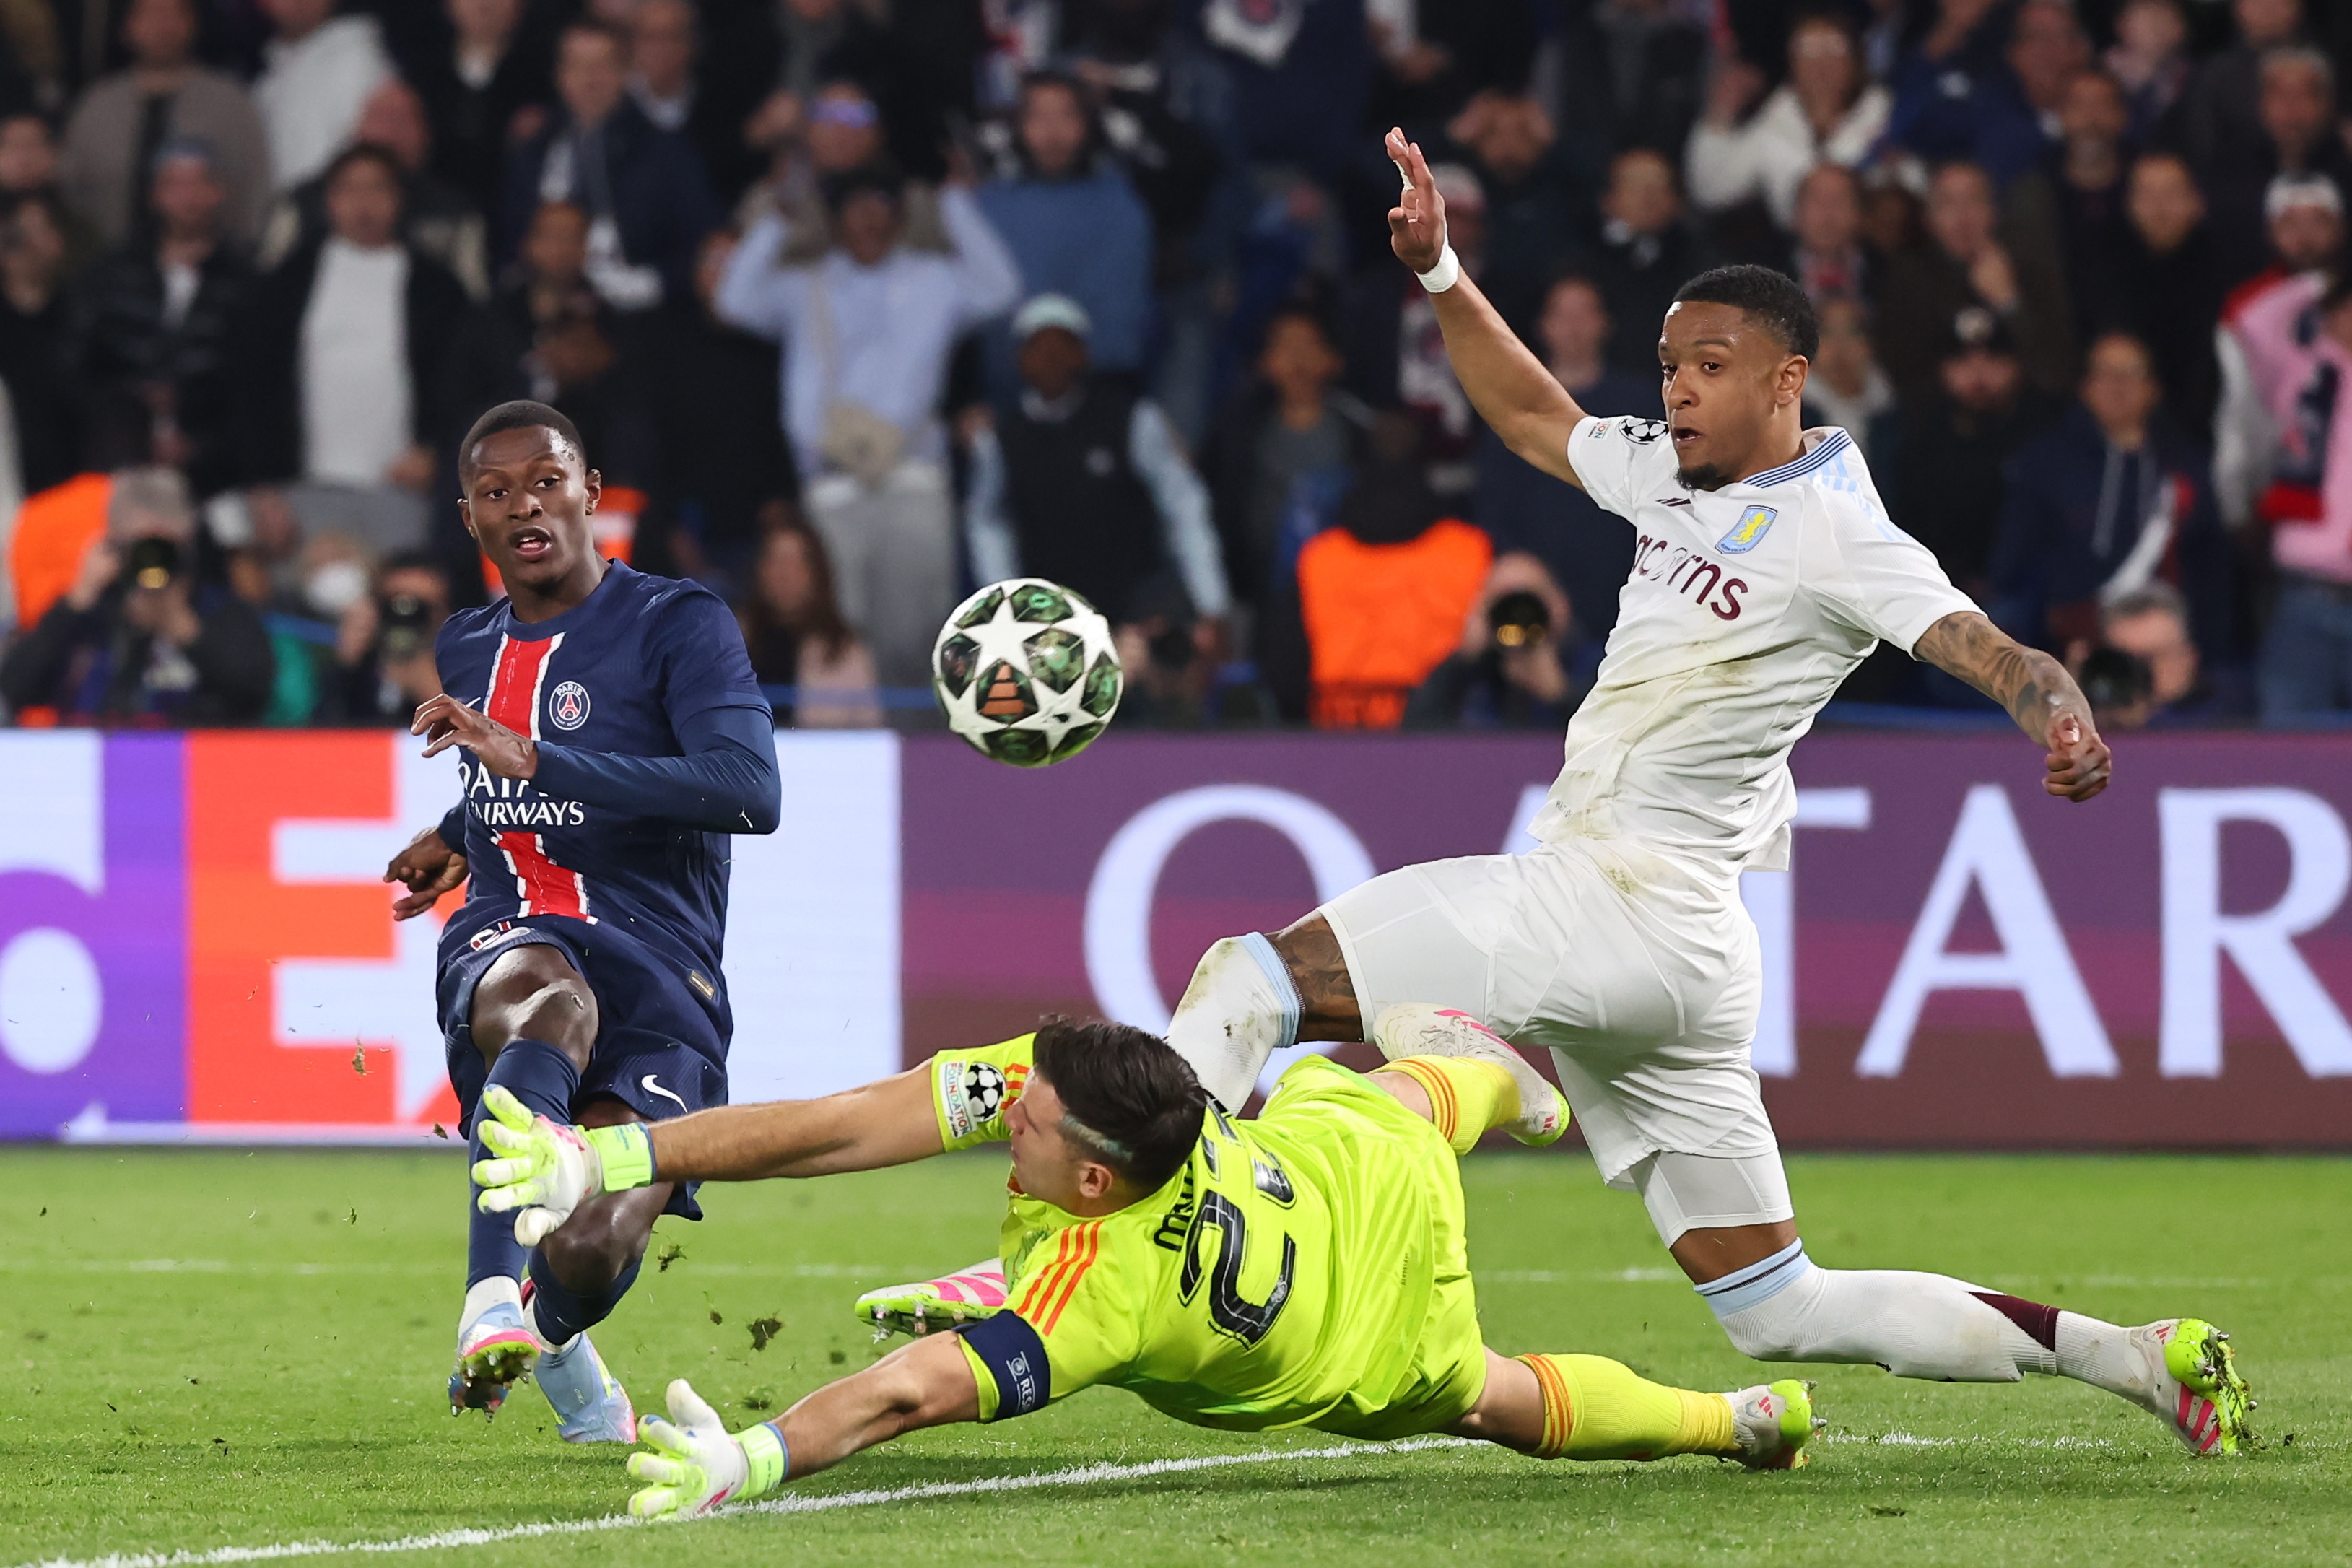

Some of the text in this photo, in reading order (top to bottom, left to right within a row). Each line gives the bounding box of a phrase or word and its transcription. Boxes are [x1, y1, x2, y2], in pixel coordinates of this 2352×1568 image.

[556, 684, 583, 697] PARIS
[1083, 782, 2351, 1097] QTAR
[948, 1063, 972, 1134] FOUNDATION
